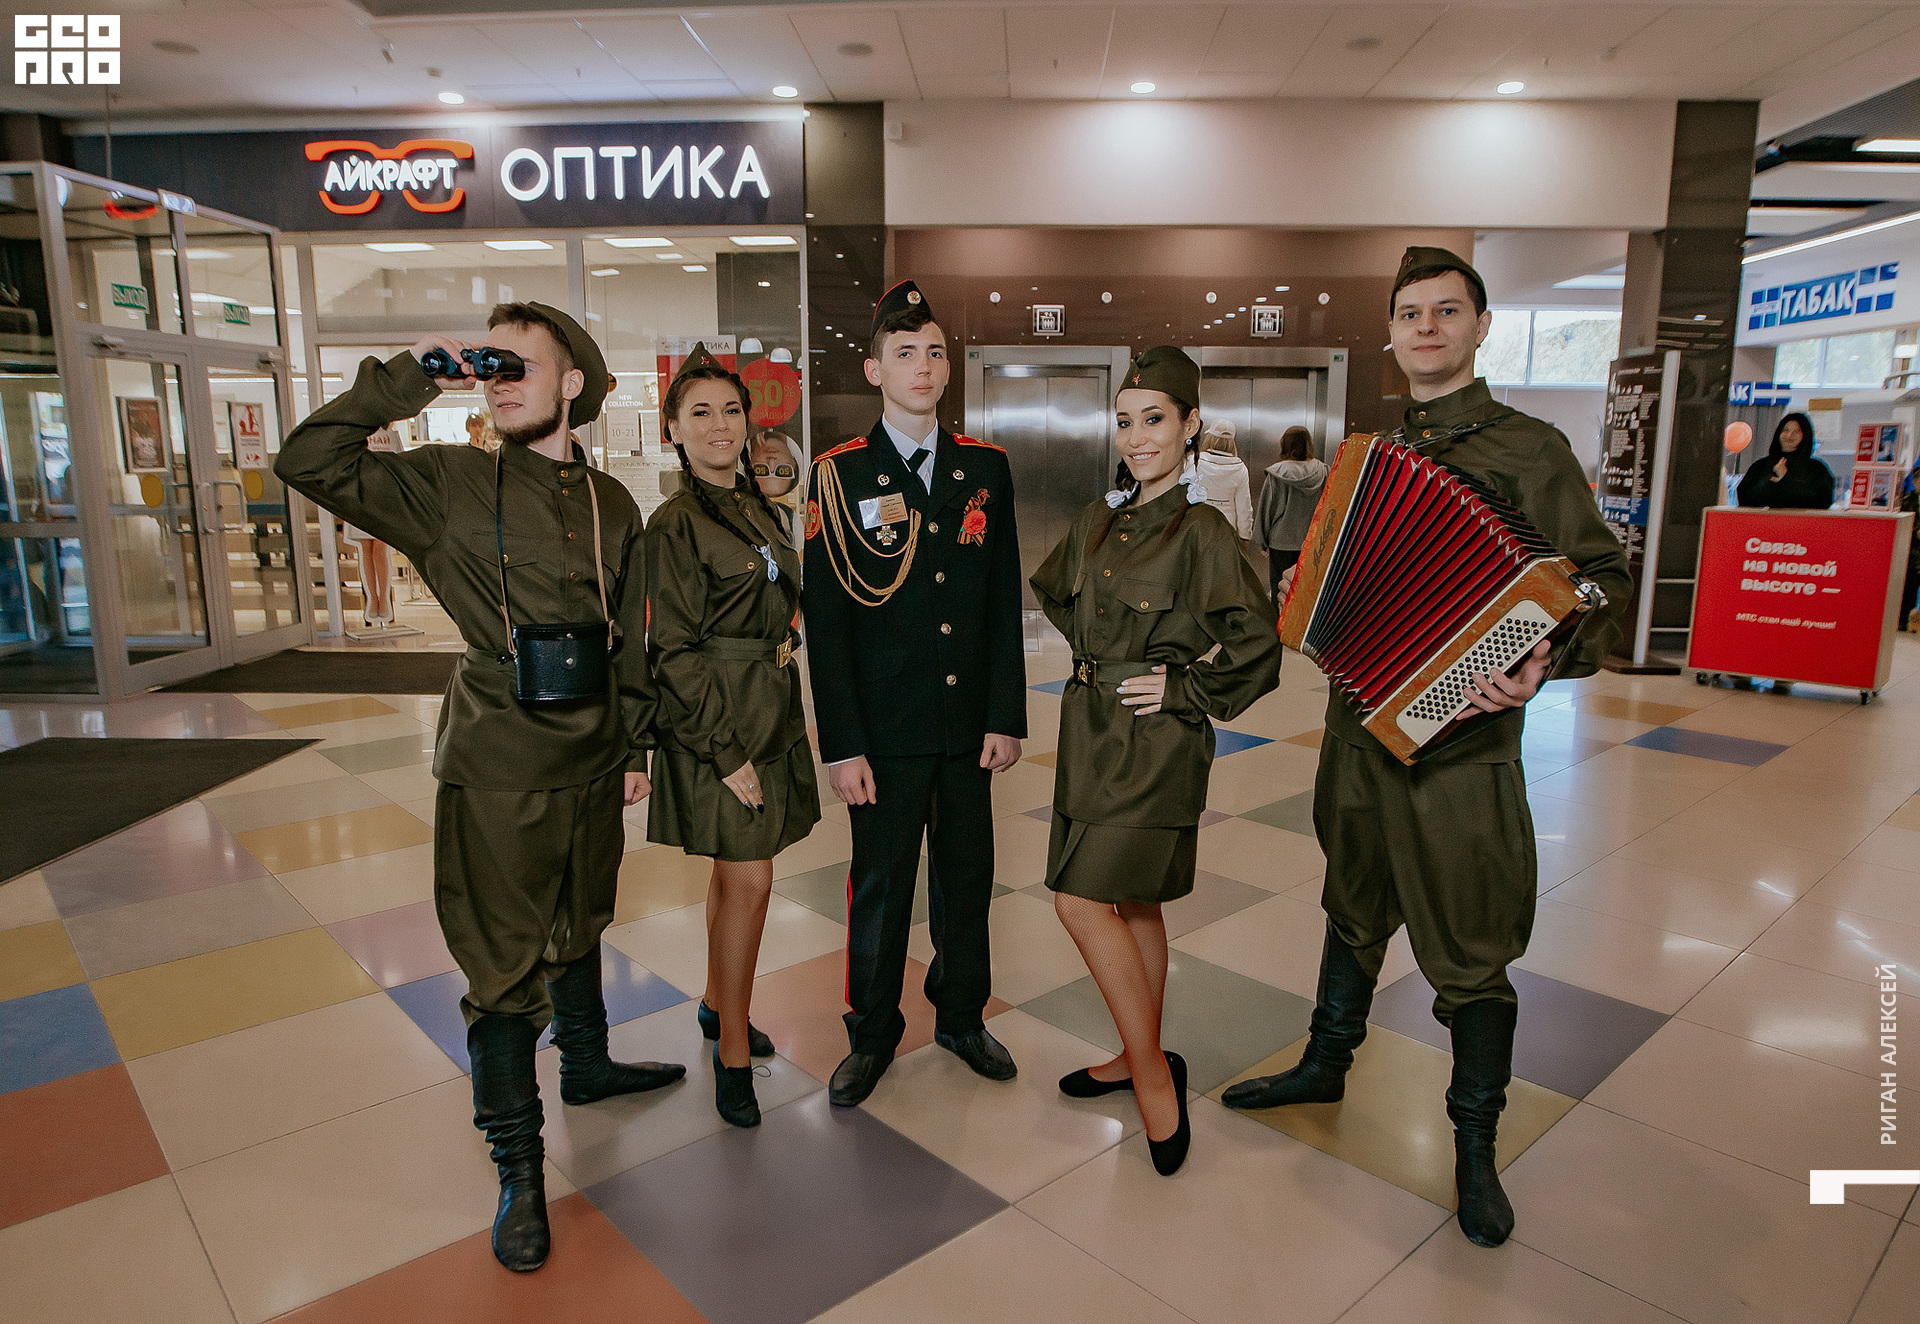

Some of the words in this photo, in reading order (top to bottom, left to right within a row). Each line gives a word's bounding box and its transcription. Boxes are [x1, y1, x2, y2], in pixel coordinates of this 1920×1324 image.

[323, 154, 459, 192] АЙКРАФТ
[500, 145, 771, 201] ОПТИКА
[1781, 278, 1856, 319] ТАБАК
[690, 341, 731, 350] ОТИКА
[1605, 402, 1614, 426] 3
[1601, 451, 1609, 474] 2
[1745, 537, 1808, 556] Связь
[1742, 560, 1768, 573] на
[1772, 560, 1838, 577] новой
[1740, 578, 1817, 595] высоте
[1736, 612, 1758, 622] МТС
[1758, 616, 1780, 625] стал
[1801, 620, 1837, 629] лучше!
